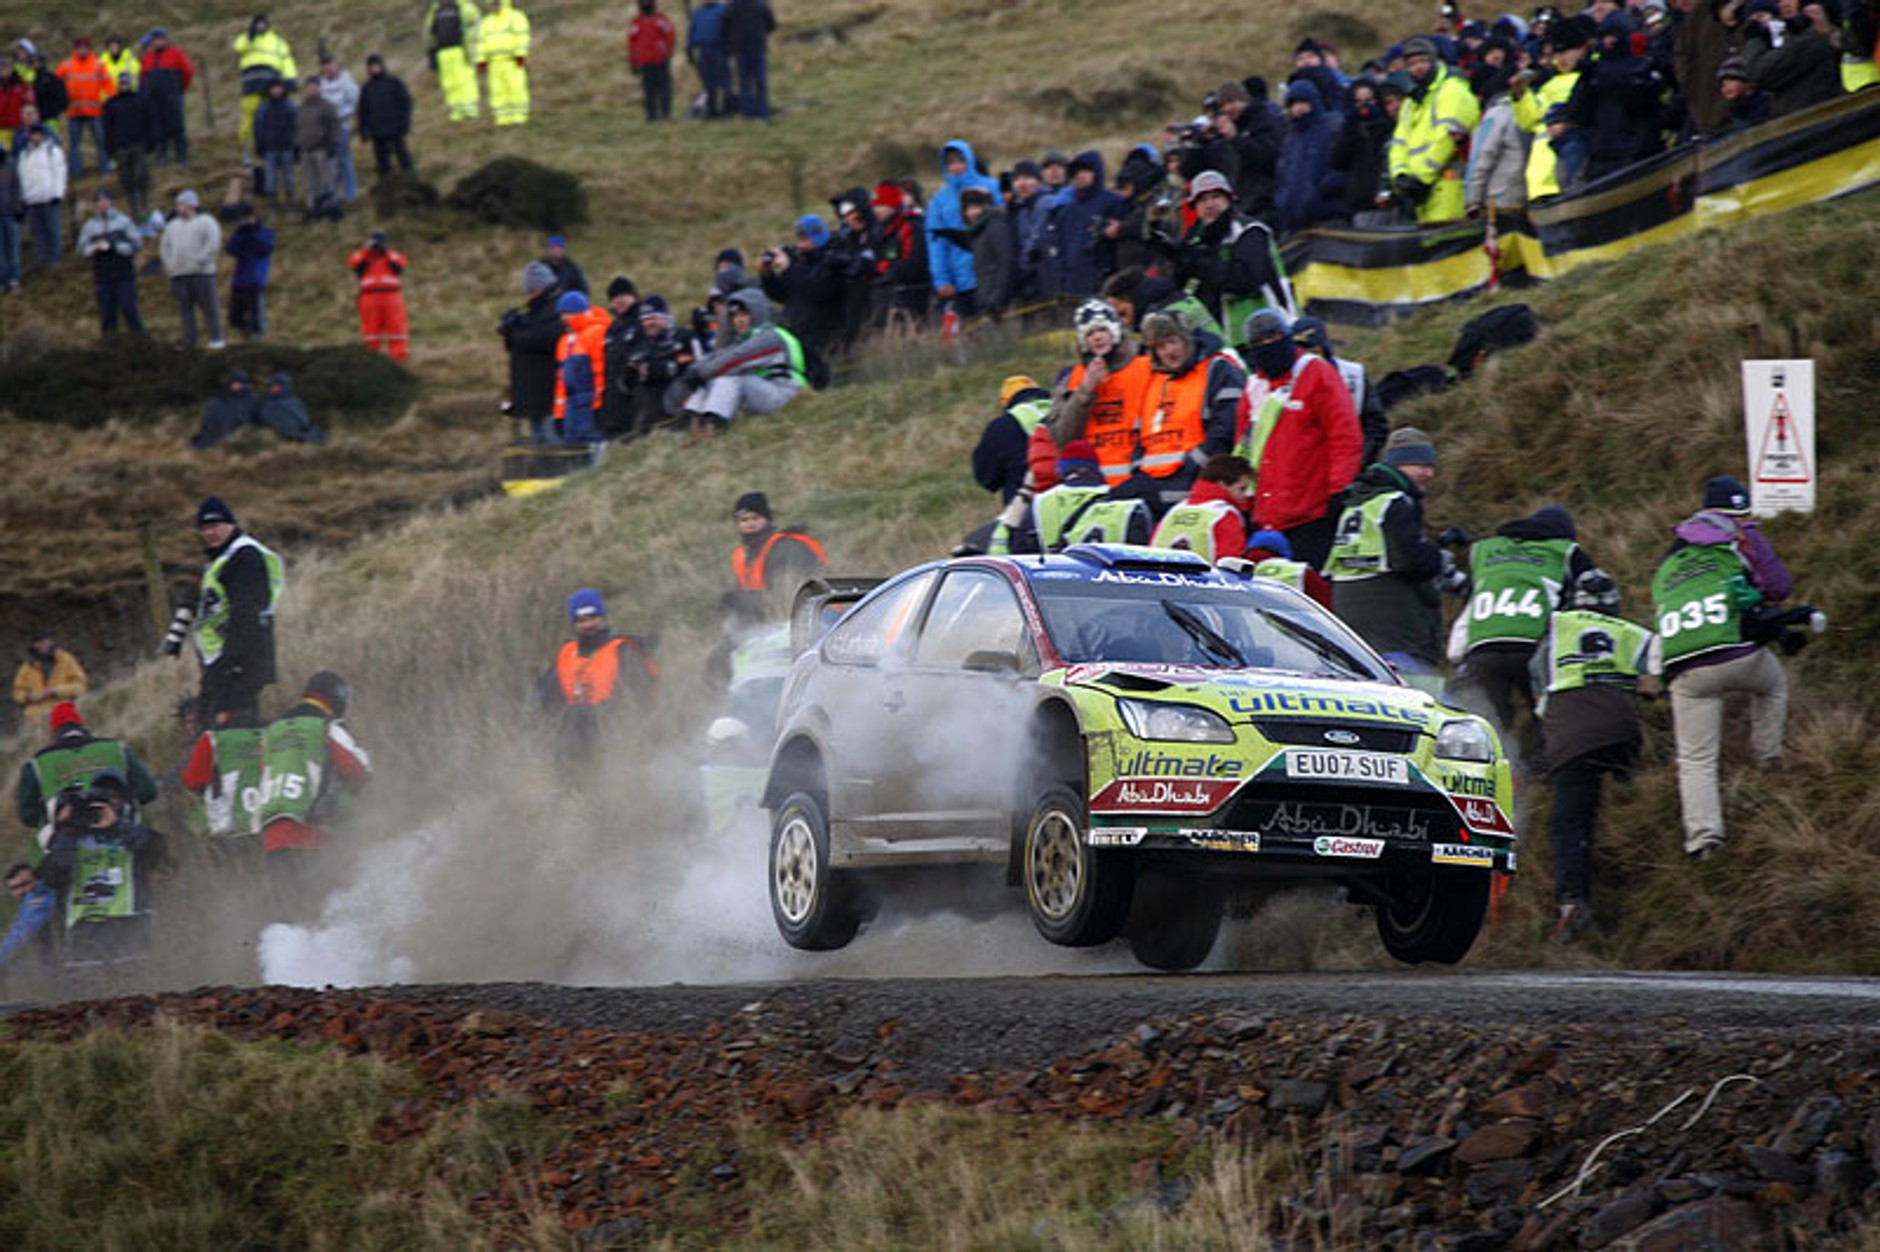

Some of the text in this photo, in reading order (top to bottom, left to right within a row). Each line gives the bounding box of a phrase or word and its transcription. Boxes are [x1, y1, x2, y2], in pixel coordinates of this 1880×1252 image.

[1474, 588, 1543, 620] 044
[1658, 592, 1728, 638] 035
[1229, 692, 1430, 724] ultimate
[1116, 751, 1244, 778] ultimate
[1296, 754, 1398, 779] EU07 SUF
[1332, 839, 1381, 857] Castrol
